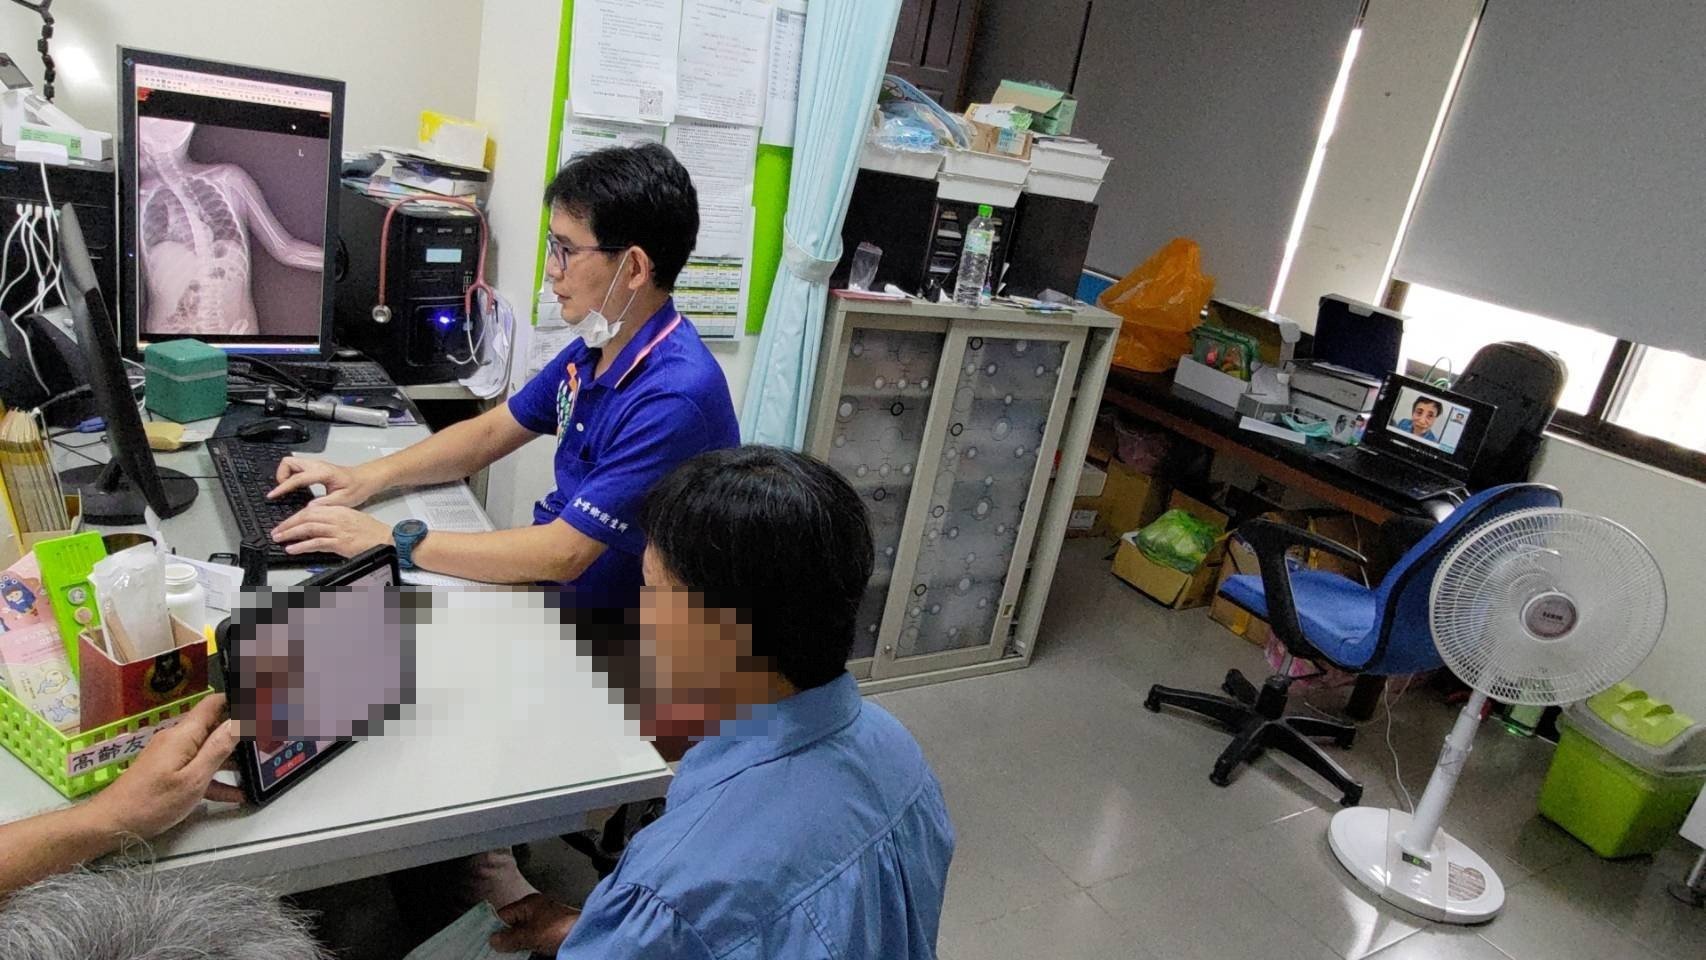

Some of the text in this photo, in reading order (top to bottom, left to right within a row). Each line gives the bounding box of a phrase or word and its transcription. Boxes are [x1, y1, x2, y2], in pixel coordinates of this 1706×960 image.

[298, 148, 304, 157] L
[72, 725, 171, 772] 高齡友
